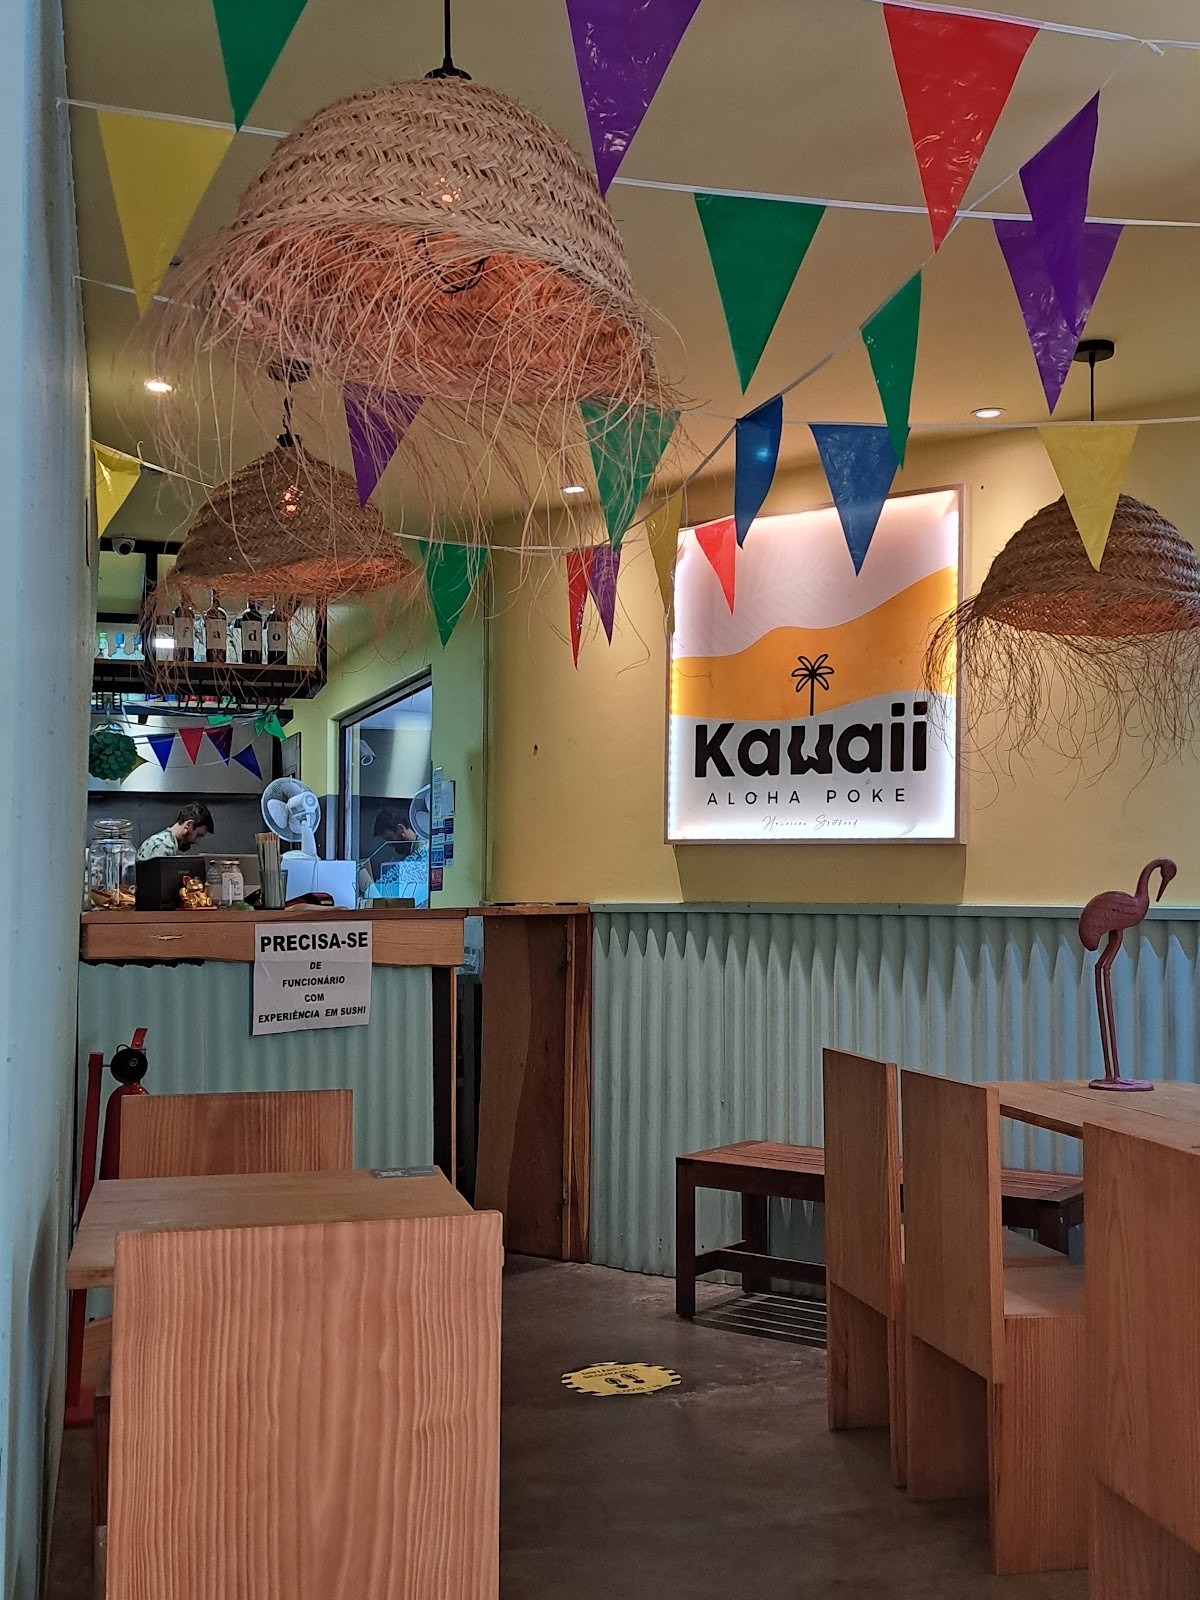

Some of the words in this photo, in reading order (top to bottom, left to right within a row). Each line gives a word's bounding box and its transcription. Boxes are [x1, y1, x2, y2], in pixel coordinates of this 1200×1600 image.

[694, 701, 927, 777] Kawaii
[707, 790, 800, 805] ALOHA
[827, 788, 905, 803] POKE
[260, 932, 368, 952] PRECISA-SE
[309, 961, 322, 970] DE
[282, 975, 345, 988] FUNCIONÁRIO
[304, 993, 324, 1002] COM
[258, 1010, 320, 1023] EXPERIÊNCIA
[325, 1008, 338, 1017] EM
[340, 1006, 366, 1016] SUSHI
